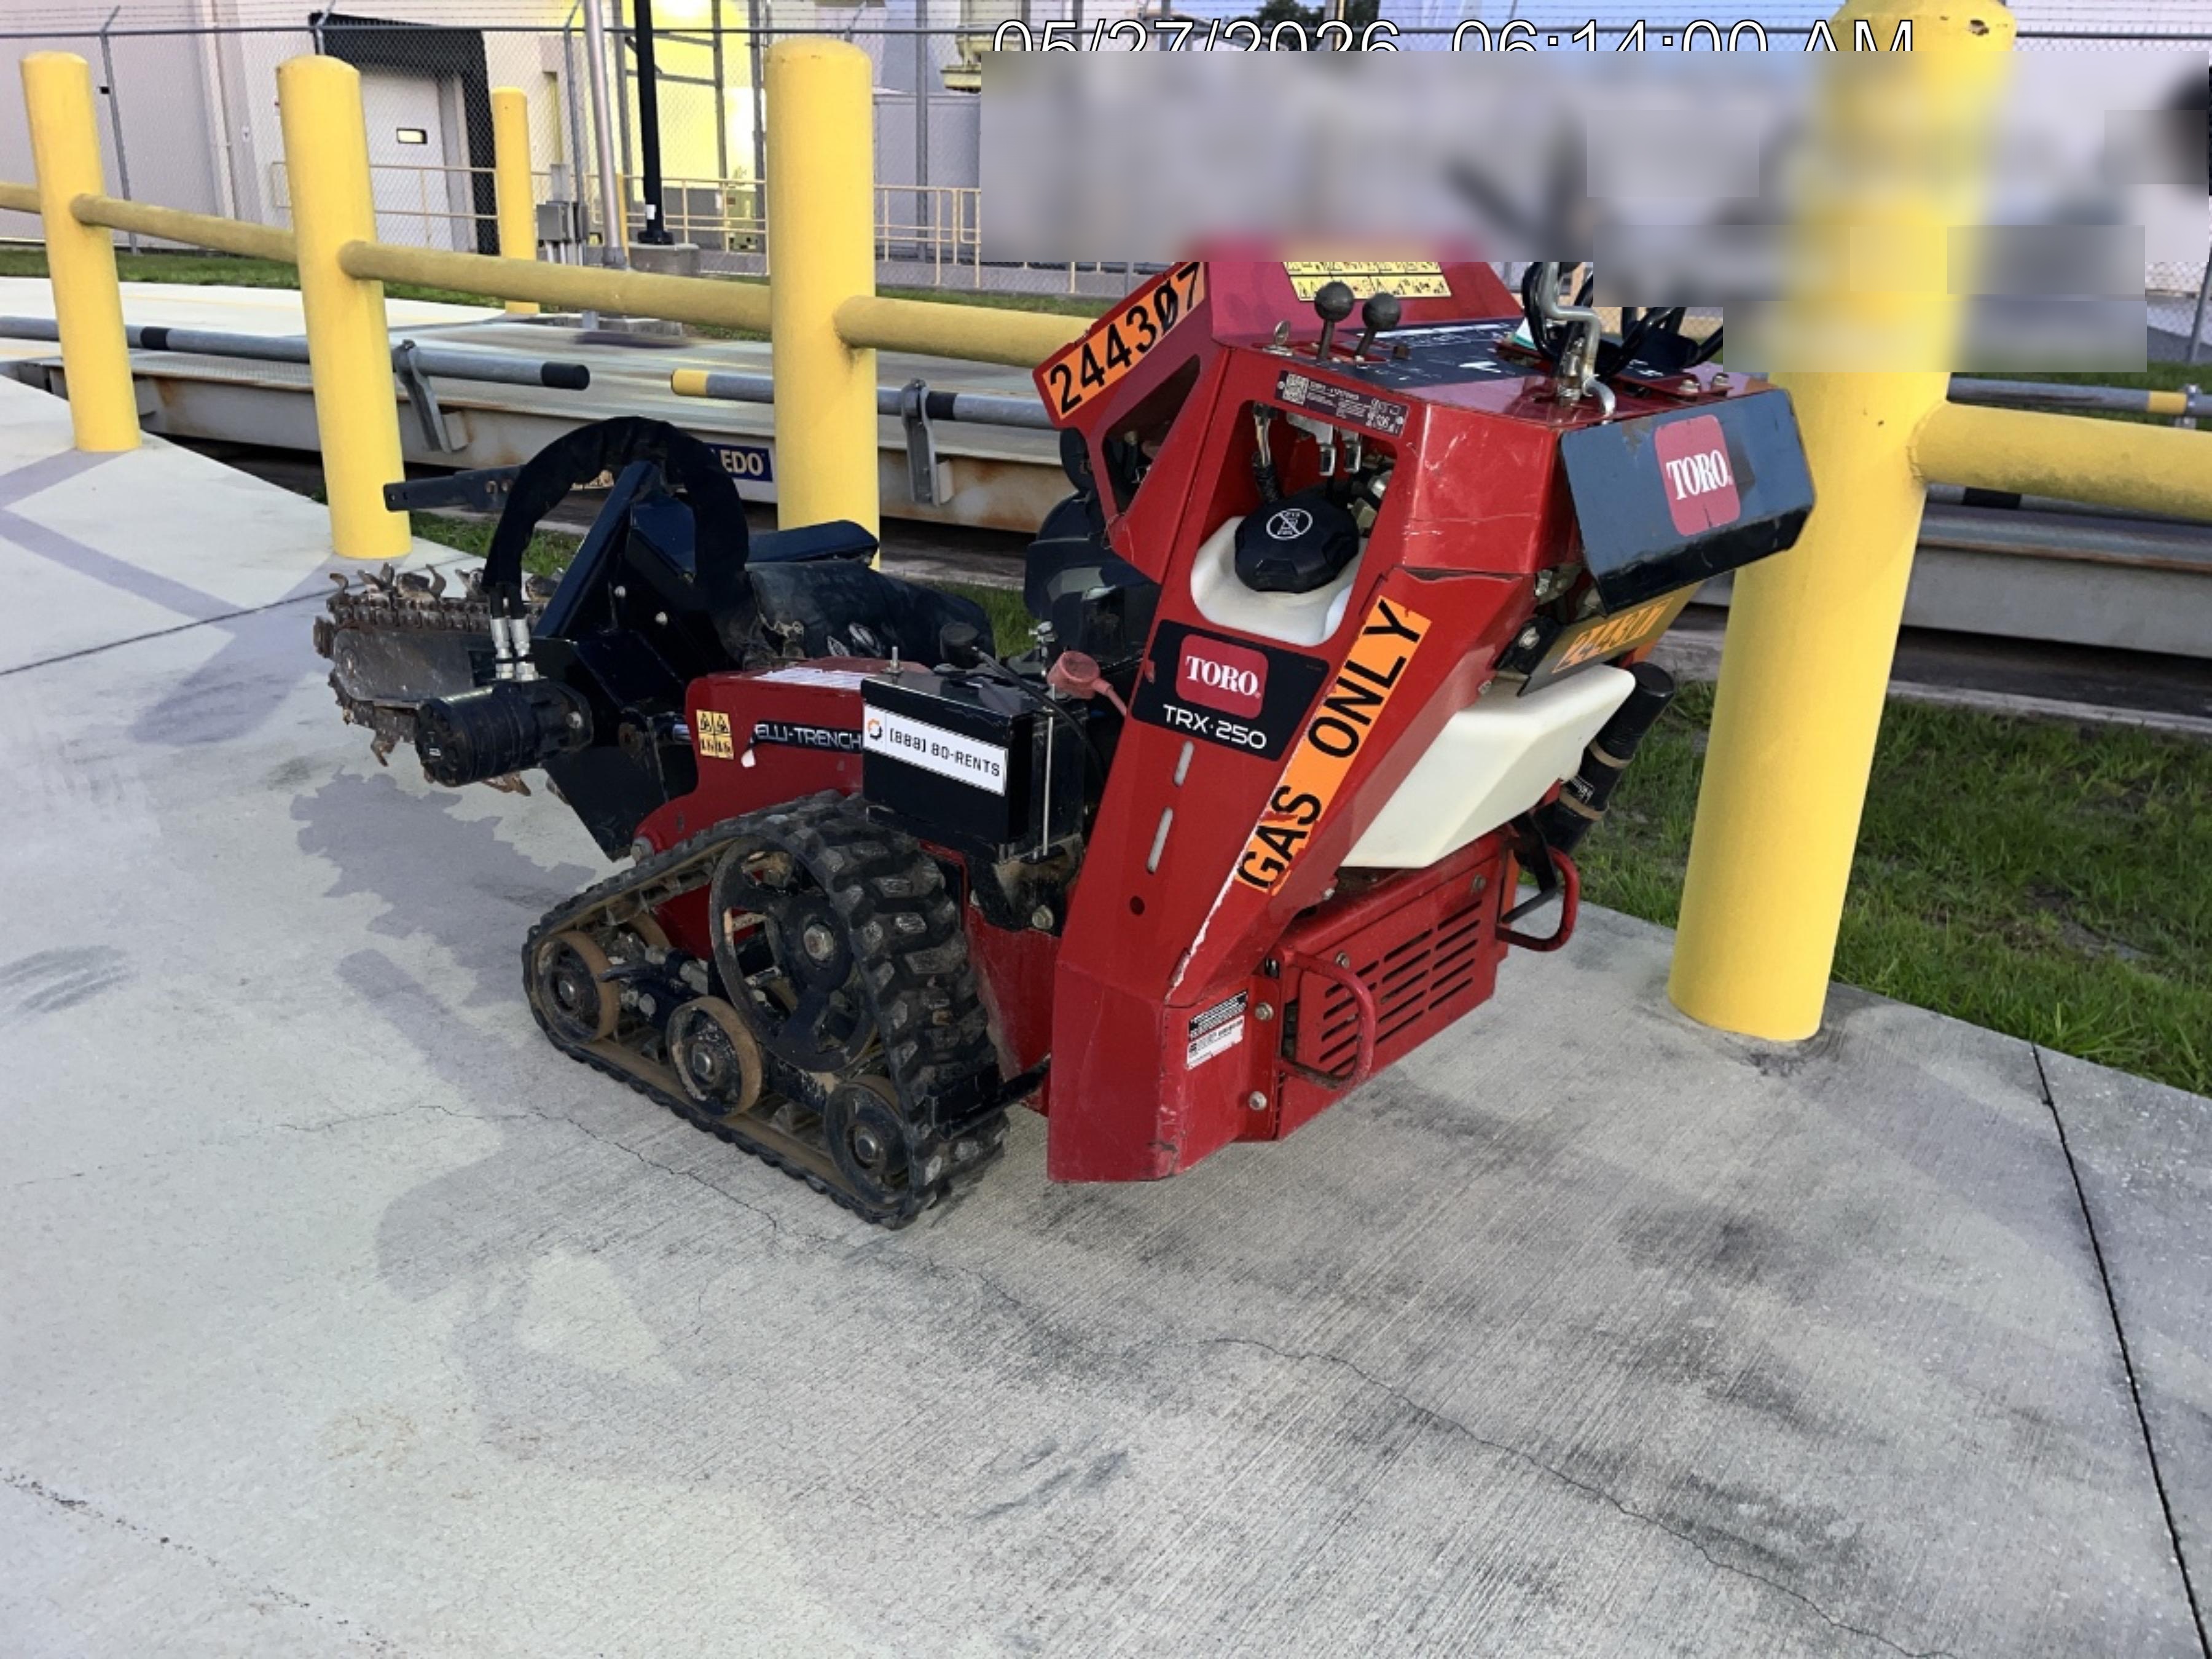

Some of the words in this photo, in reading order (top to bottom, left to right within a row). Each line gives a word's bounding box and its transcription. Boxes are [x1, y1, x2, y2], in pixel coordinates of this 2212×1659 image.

[720, 449, 764, 476] EDO
[1666, 449, 1728, 500] TORO
[1185, 655, 1258, 696] TORO
[931, 742, 1000, 777] 80-RENTS
[1236, 785, 1322, 889] GAS
[1308, 598, 1421, 758] ONLY
